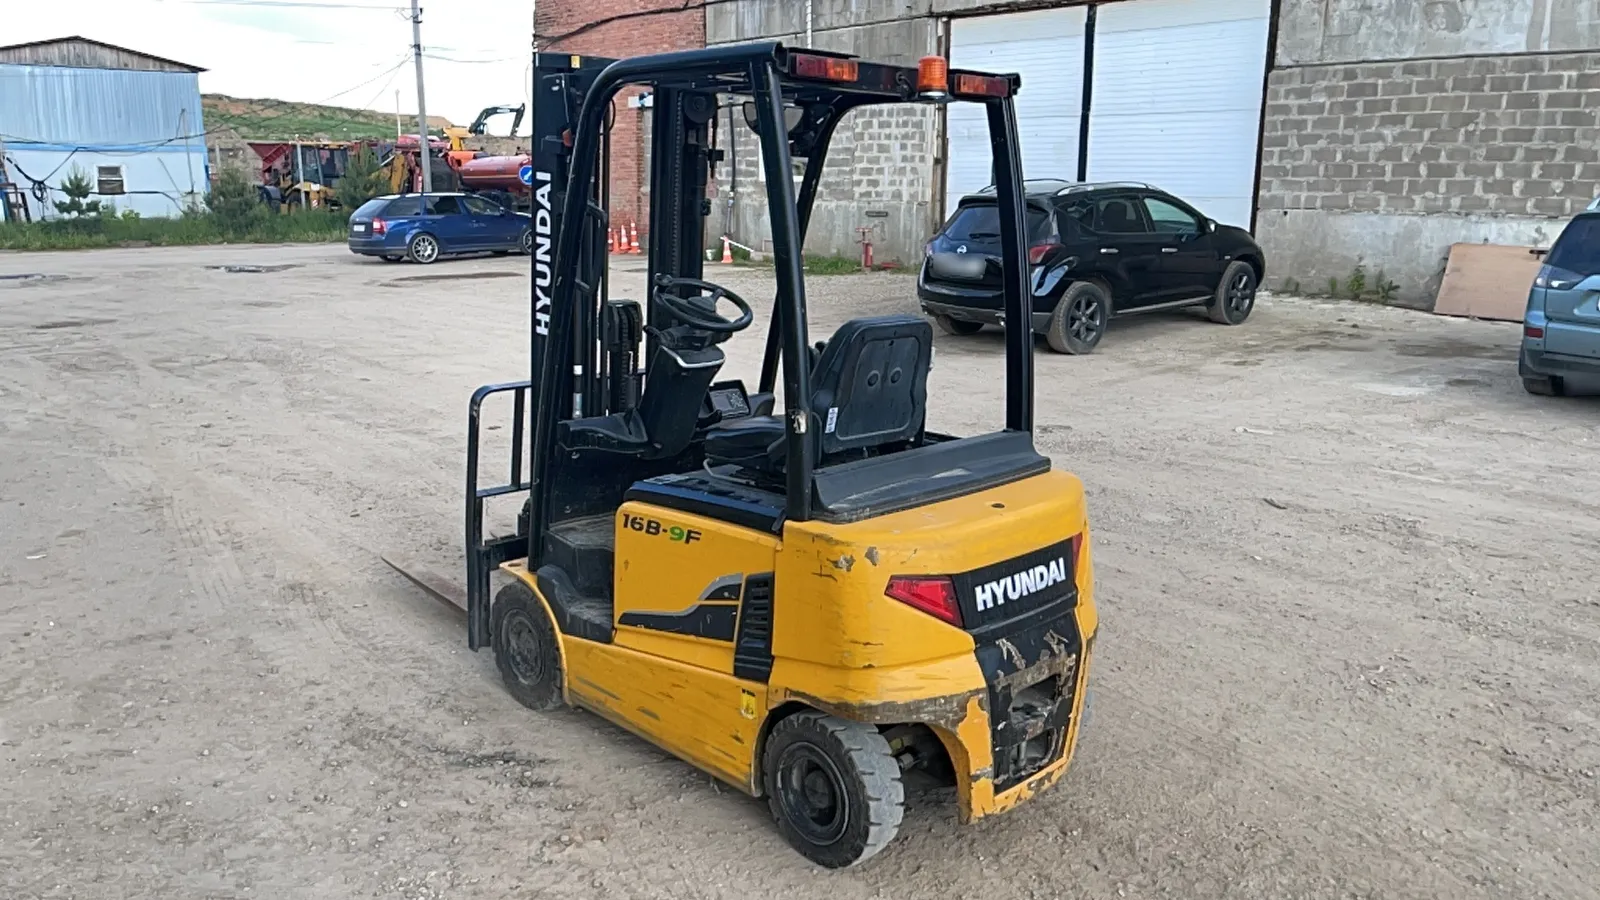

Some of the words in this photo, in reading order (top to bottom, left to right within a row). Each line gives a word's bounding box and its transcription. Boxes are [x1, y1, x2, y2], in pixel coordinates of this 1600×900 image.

[535, 171, 552, 335] HYUNDAI
[623, 514, 702, 544] 16B-9F
[975, 558, 1066, 612] HYUNDAI
